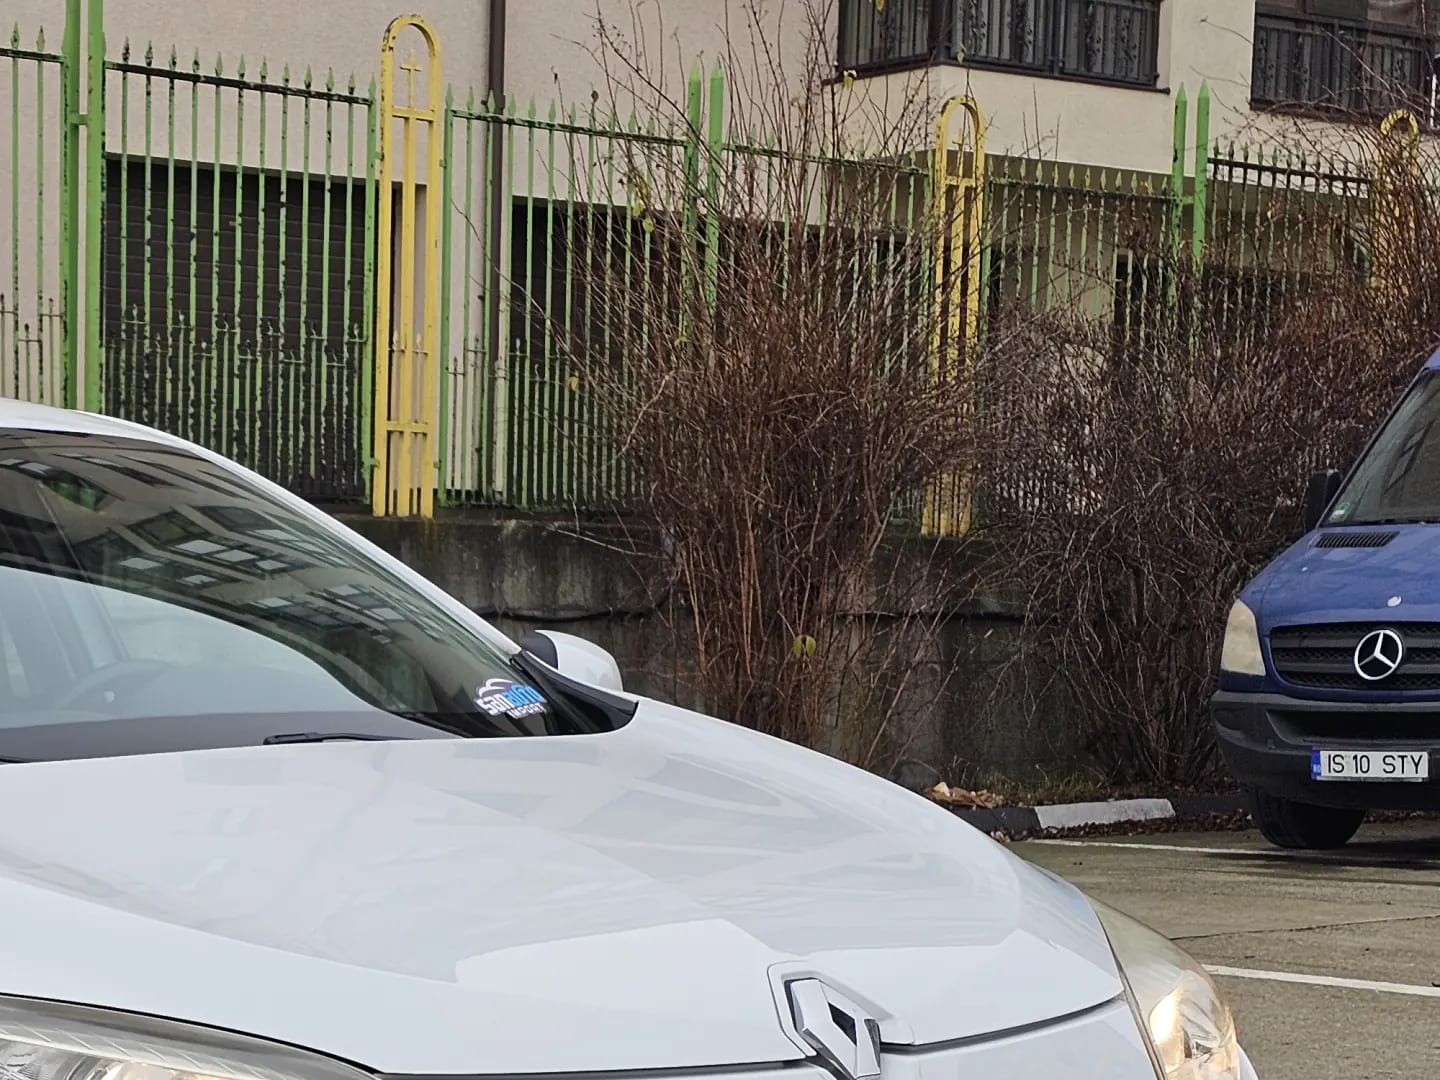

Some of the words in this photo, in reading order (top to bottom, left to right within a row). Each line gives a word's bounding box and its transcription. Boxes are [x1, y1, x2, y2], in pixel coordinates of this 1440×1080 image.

[1328, 754, 1345, 773] IS
[1352, 754, 1370, 774] 10
[1382, 754, 1423, 774] STY
